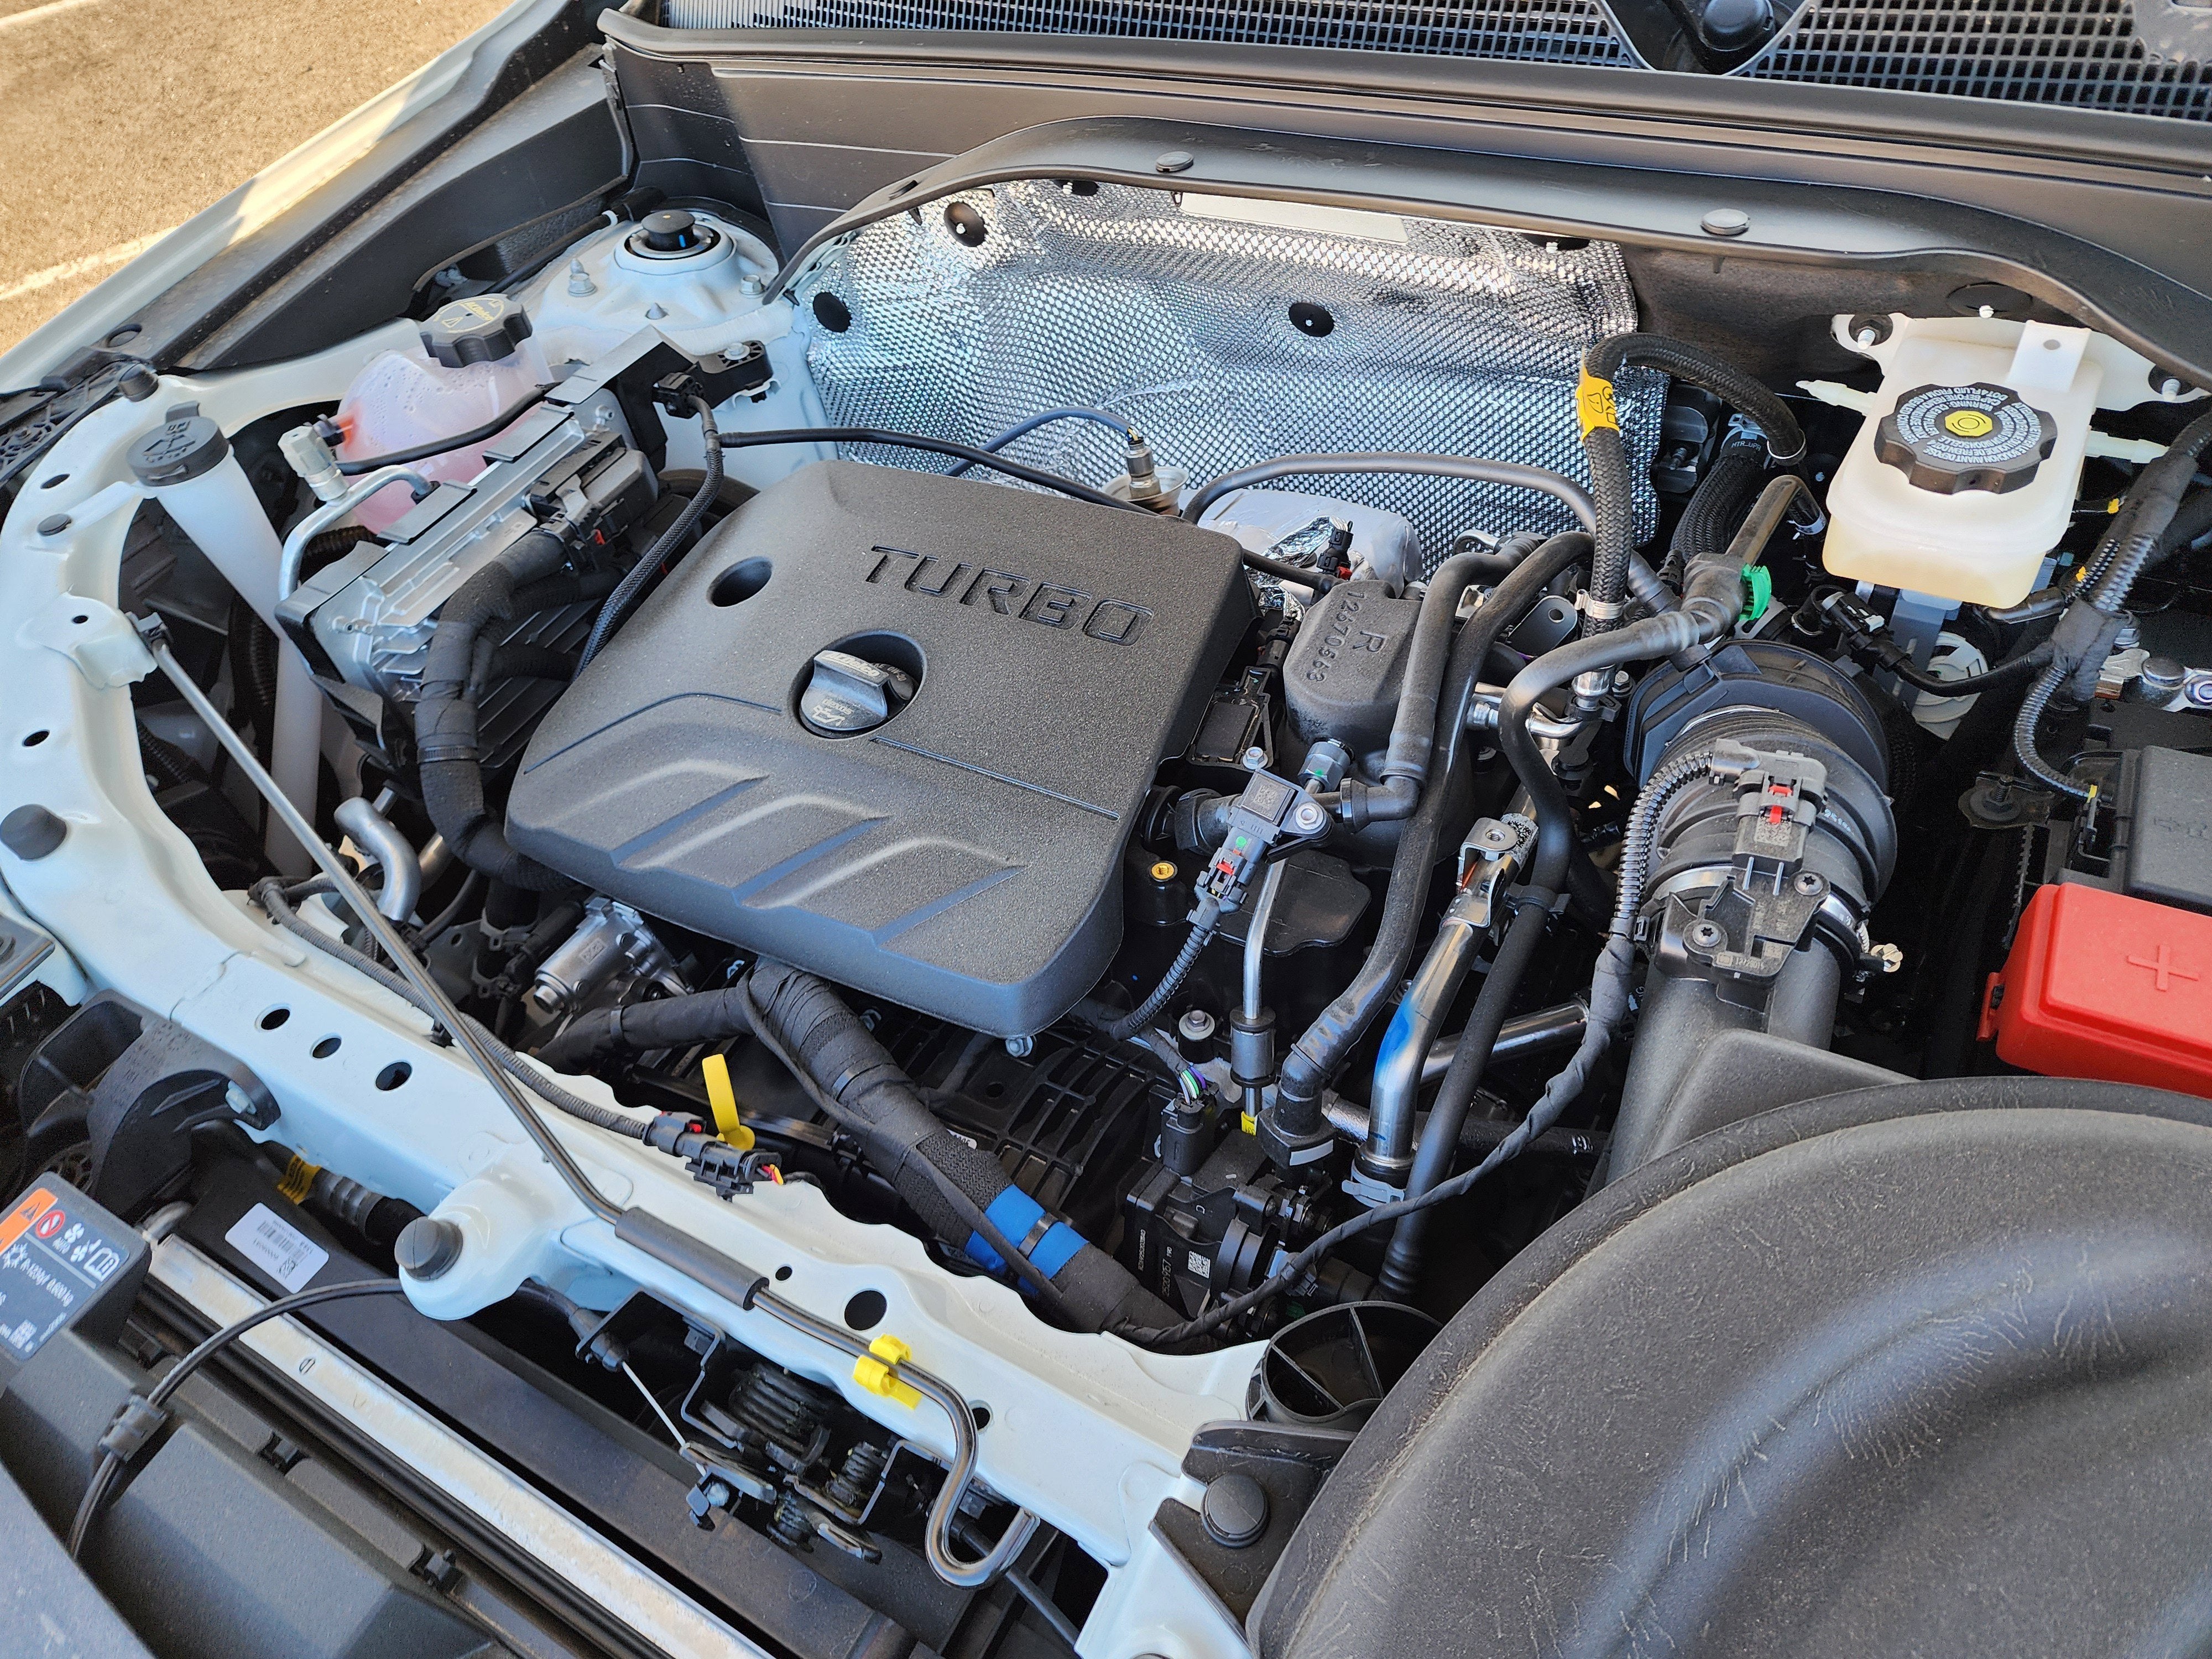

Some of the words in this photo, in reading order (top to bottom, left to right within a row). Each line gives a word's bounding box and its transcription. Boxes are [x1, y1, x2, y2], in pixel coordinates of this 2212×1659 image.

[1924, 387, 1954, 399] FROM
[1944, 393, 1983, 402] BEFORE
[1981, 394, 2002, 406] CAP
[1898, 396, 1926, 415] SEALED
[1955, 454, 1985, 463] AVANT
[865, 545, 1155, 647] TURBO
[1306, 591, 1365, 682] 12670563
[1352, 630, 1385, 653] R
